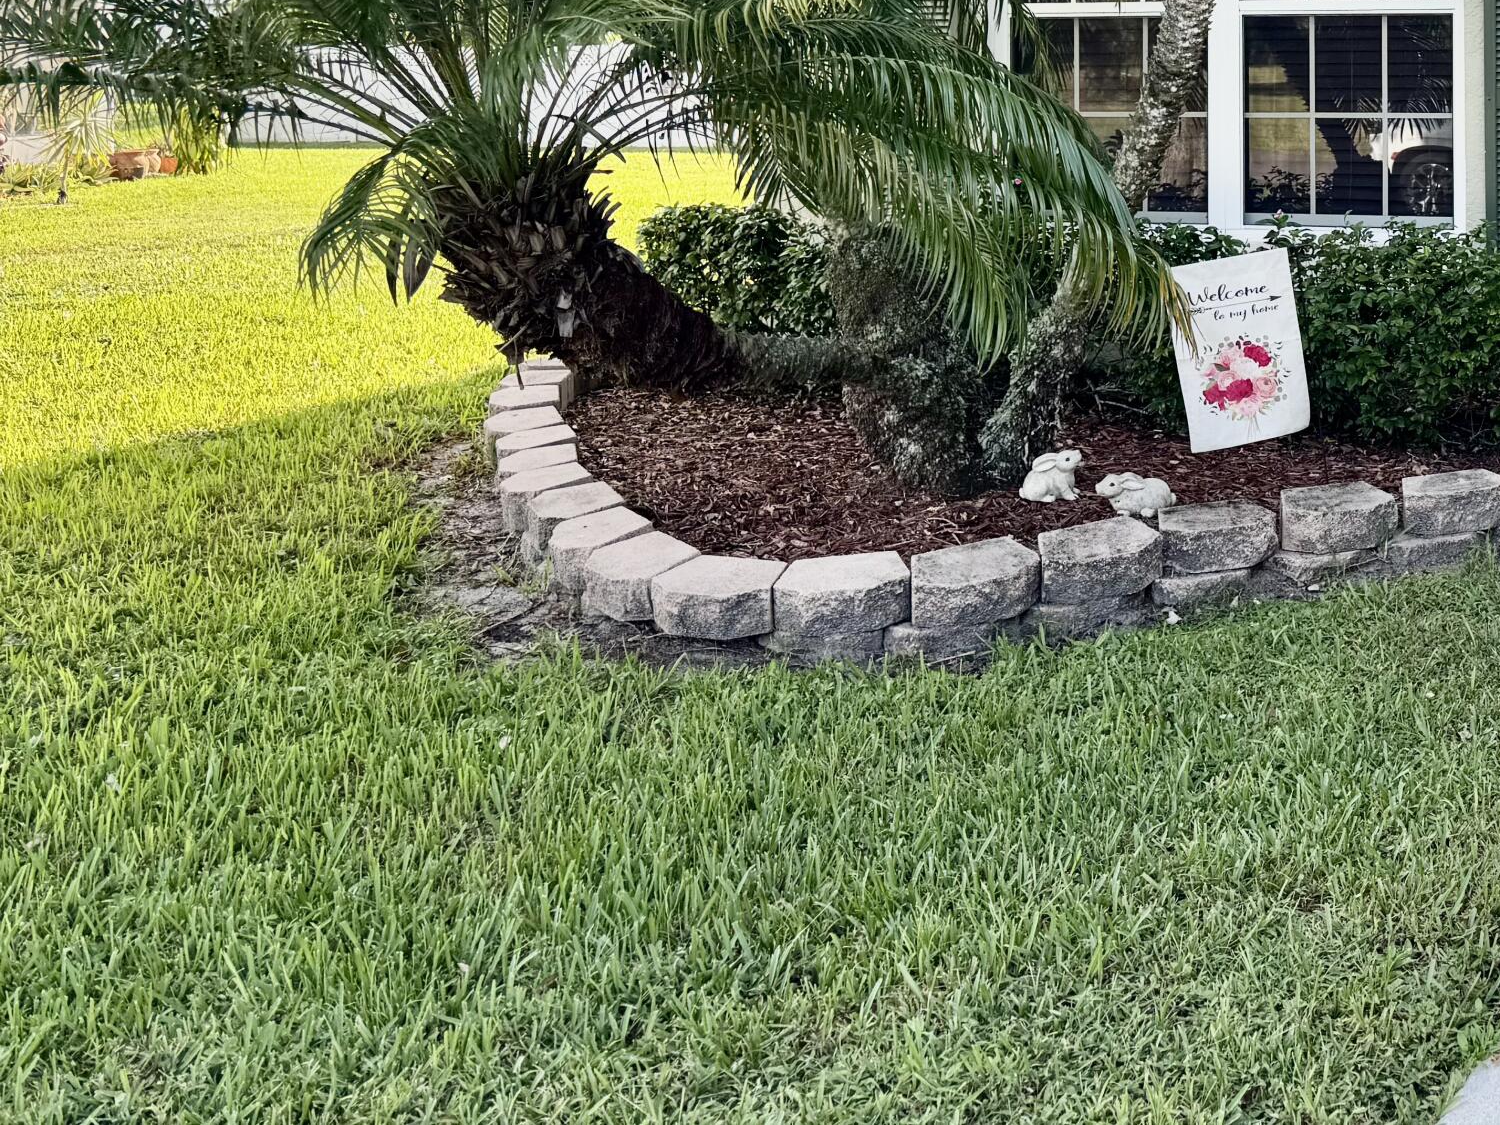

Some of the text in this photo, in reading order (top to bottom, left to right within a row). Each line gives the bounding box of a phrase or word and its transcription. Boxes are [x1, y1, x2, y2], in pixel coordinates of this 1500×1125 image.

[1187, 283, 1270, 306] Welcome
[1213, 304, 1279, 322] to my home
